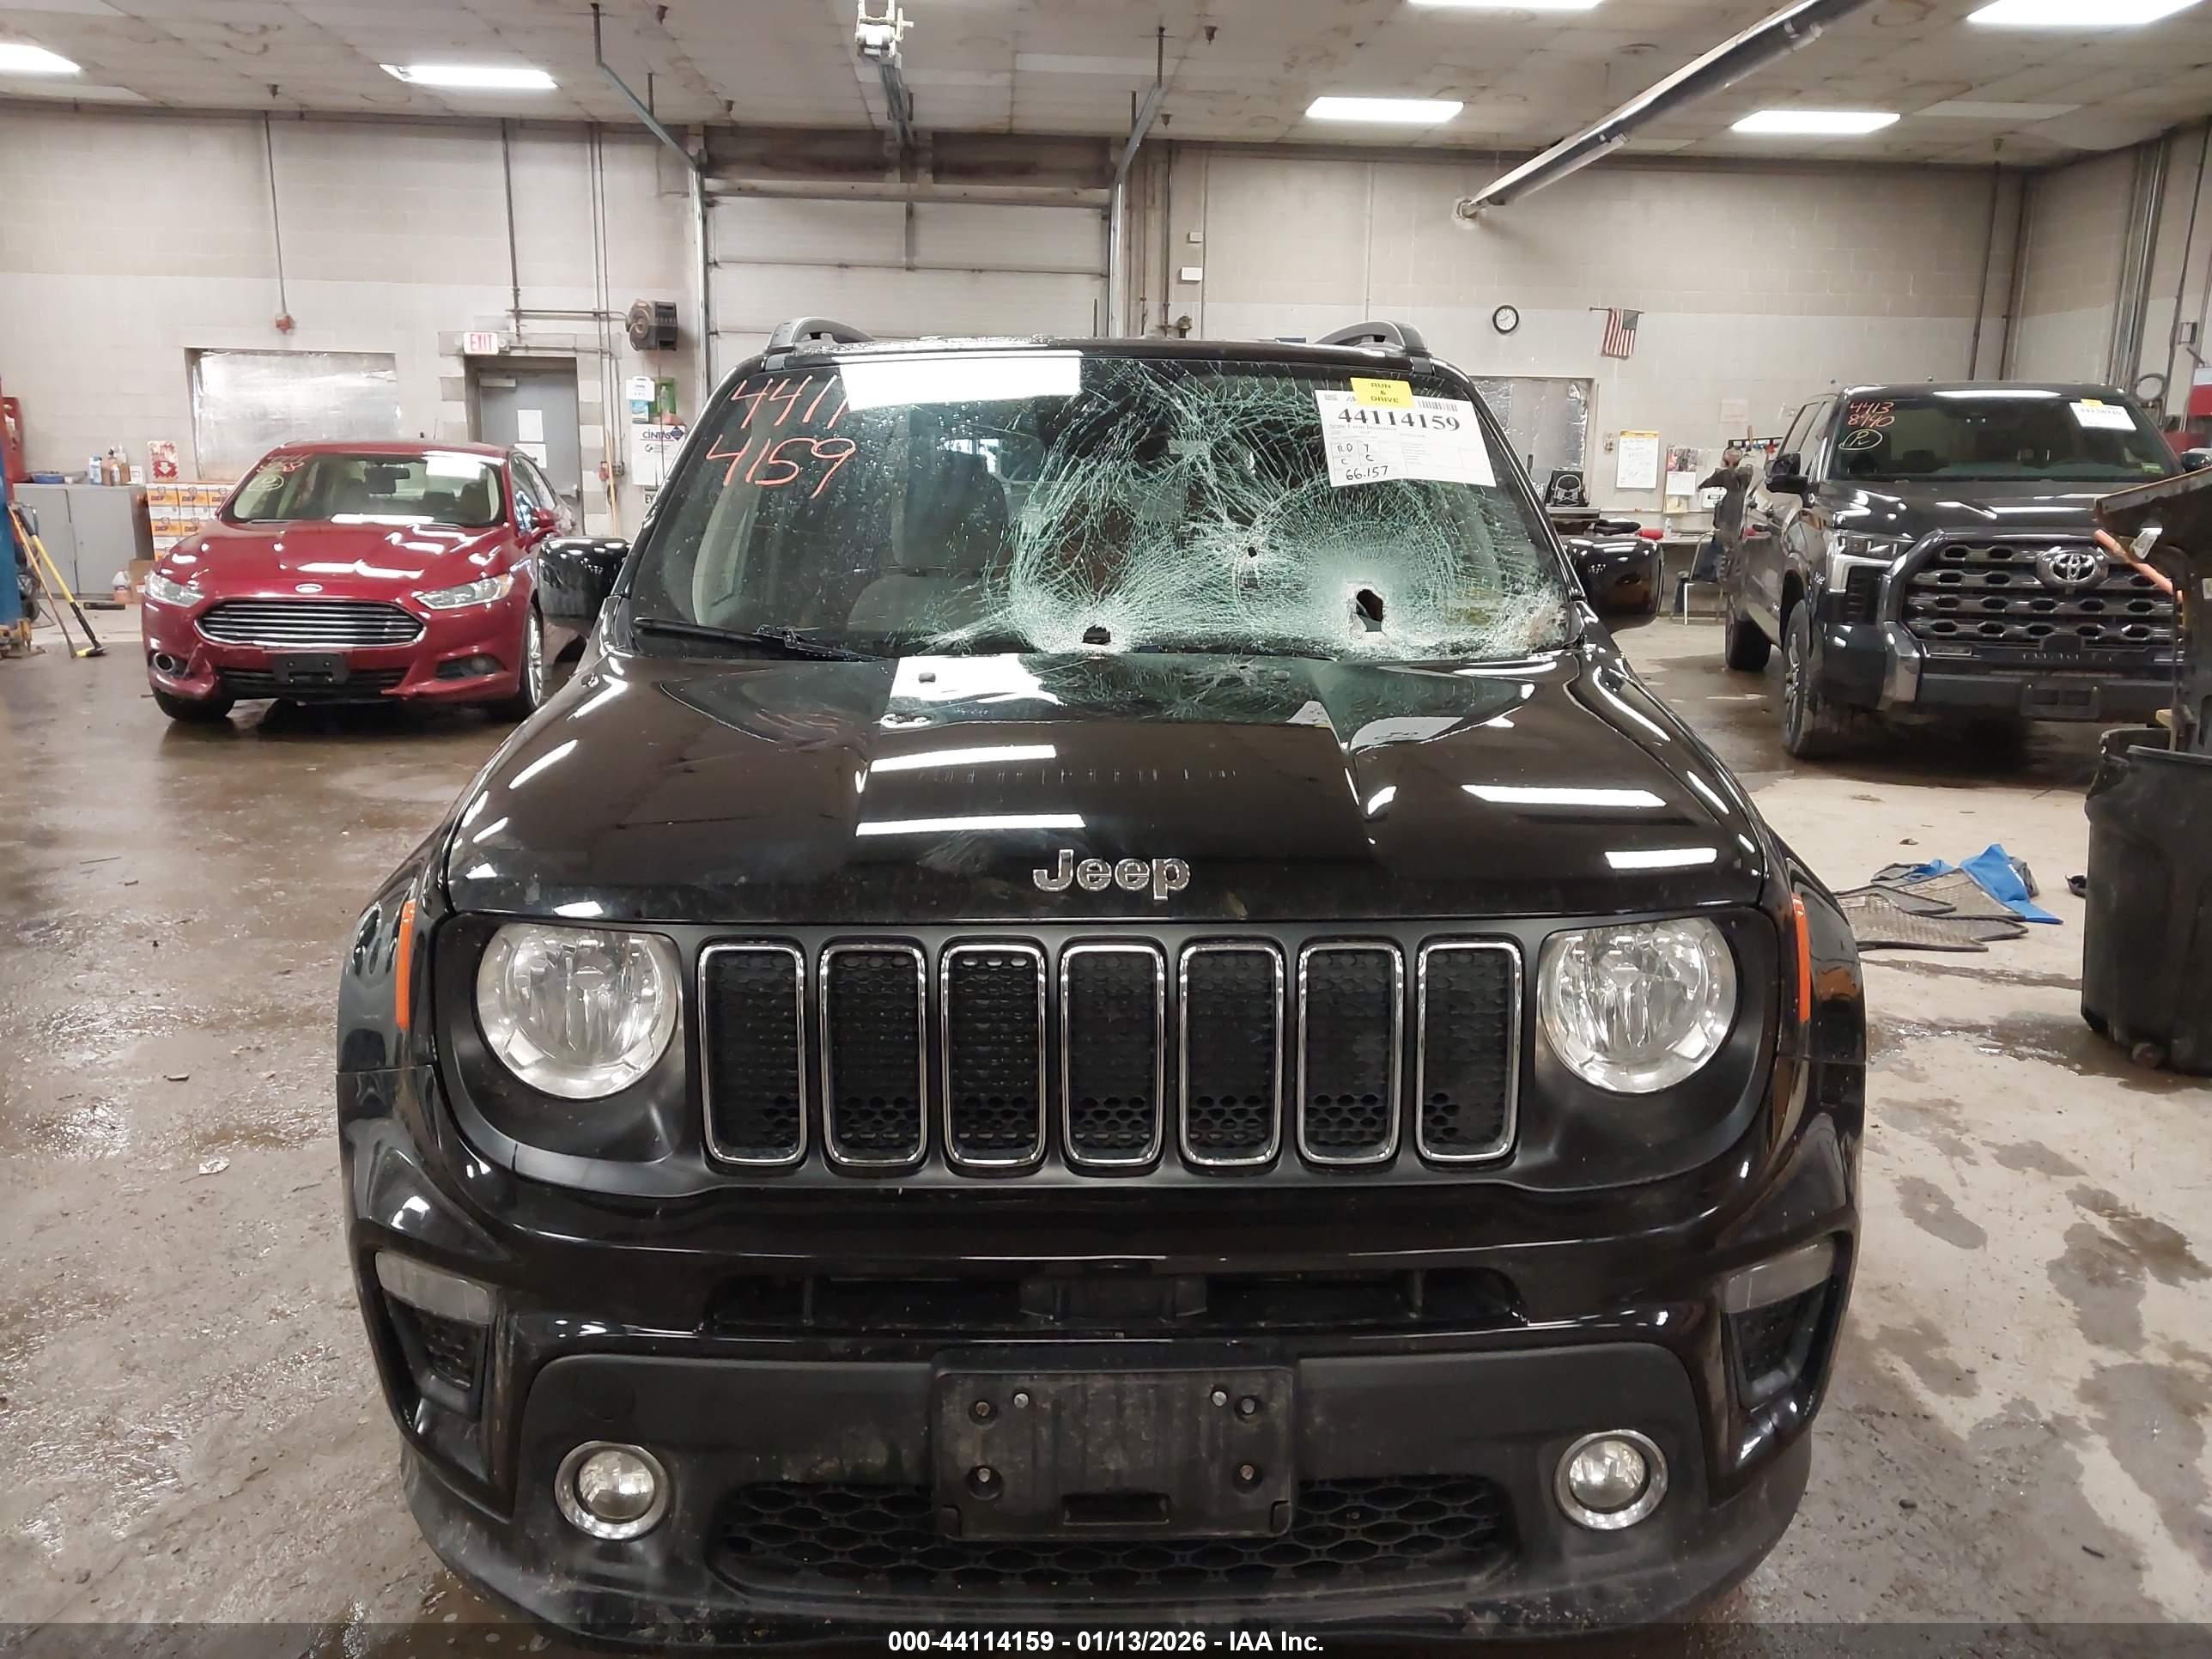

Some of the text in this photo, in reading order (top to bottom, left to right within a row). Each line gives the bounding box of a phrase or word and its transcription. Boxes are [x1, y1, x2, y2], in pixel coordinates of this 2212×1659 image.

[470, 334, 492, 351] EXIT
[1850, 401, 1894, 414] 4413
[1338, 408, 1461, 431] 44114159
[706, 434, 856, 500] 4159
[1032, 848, 1190, 901] Jeep
